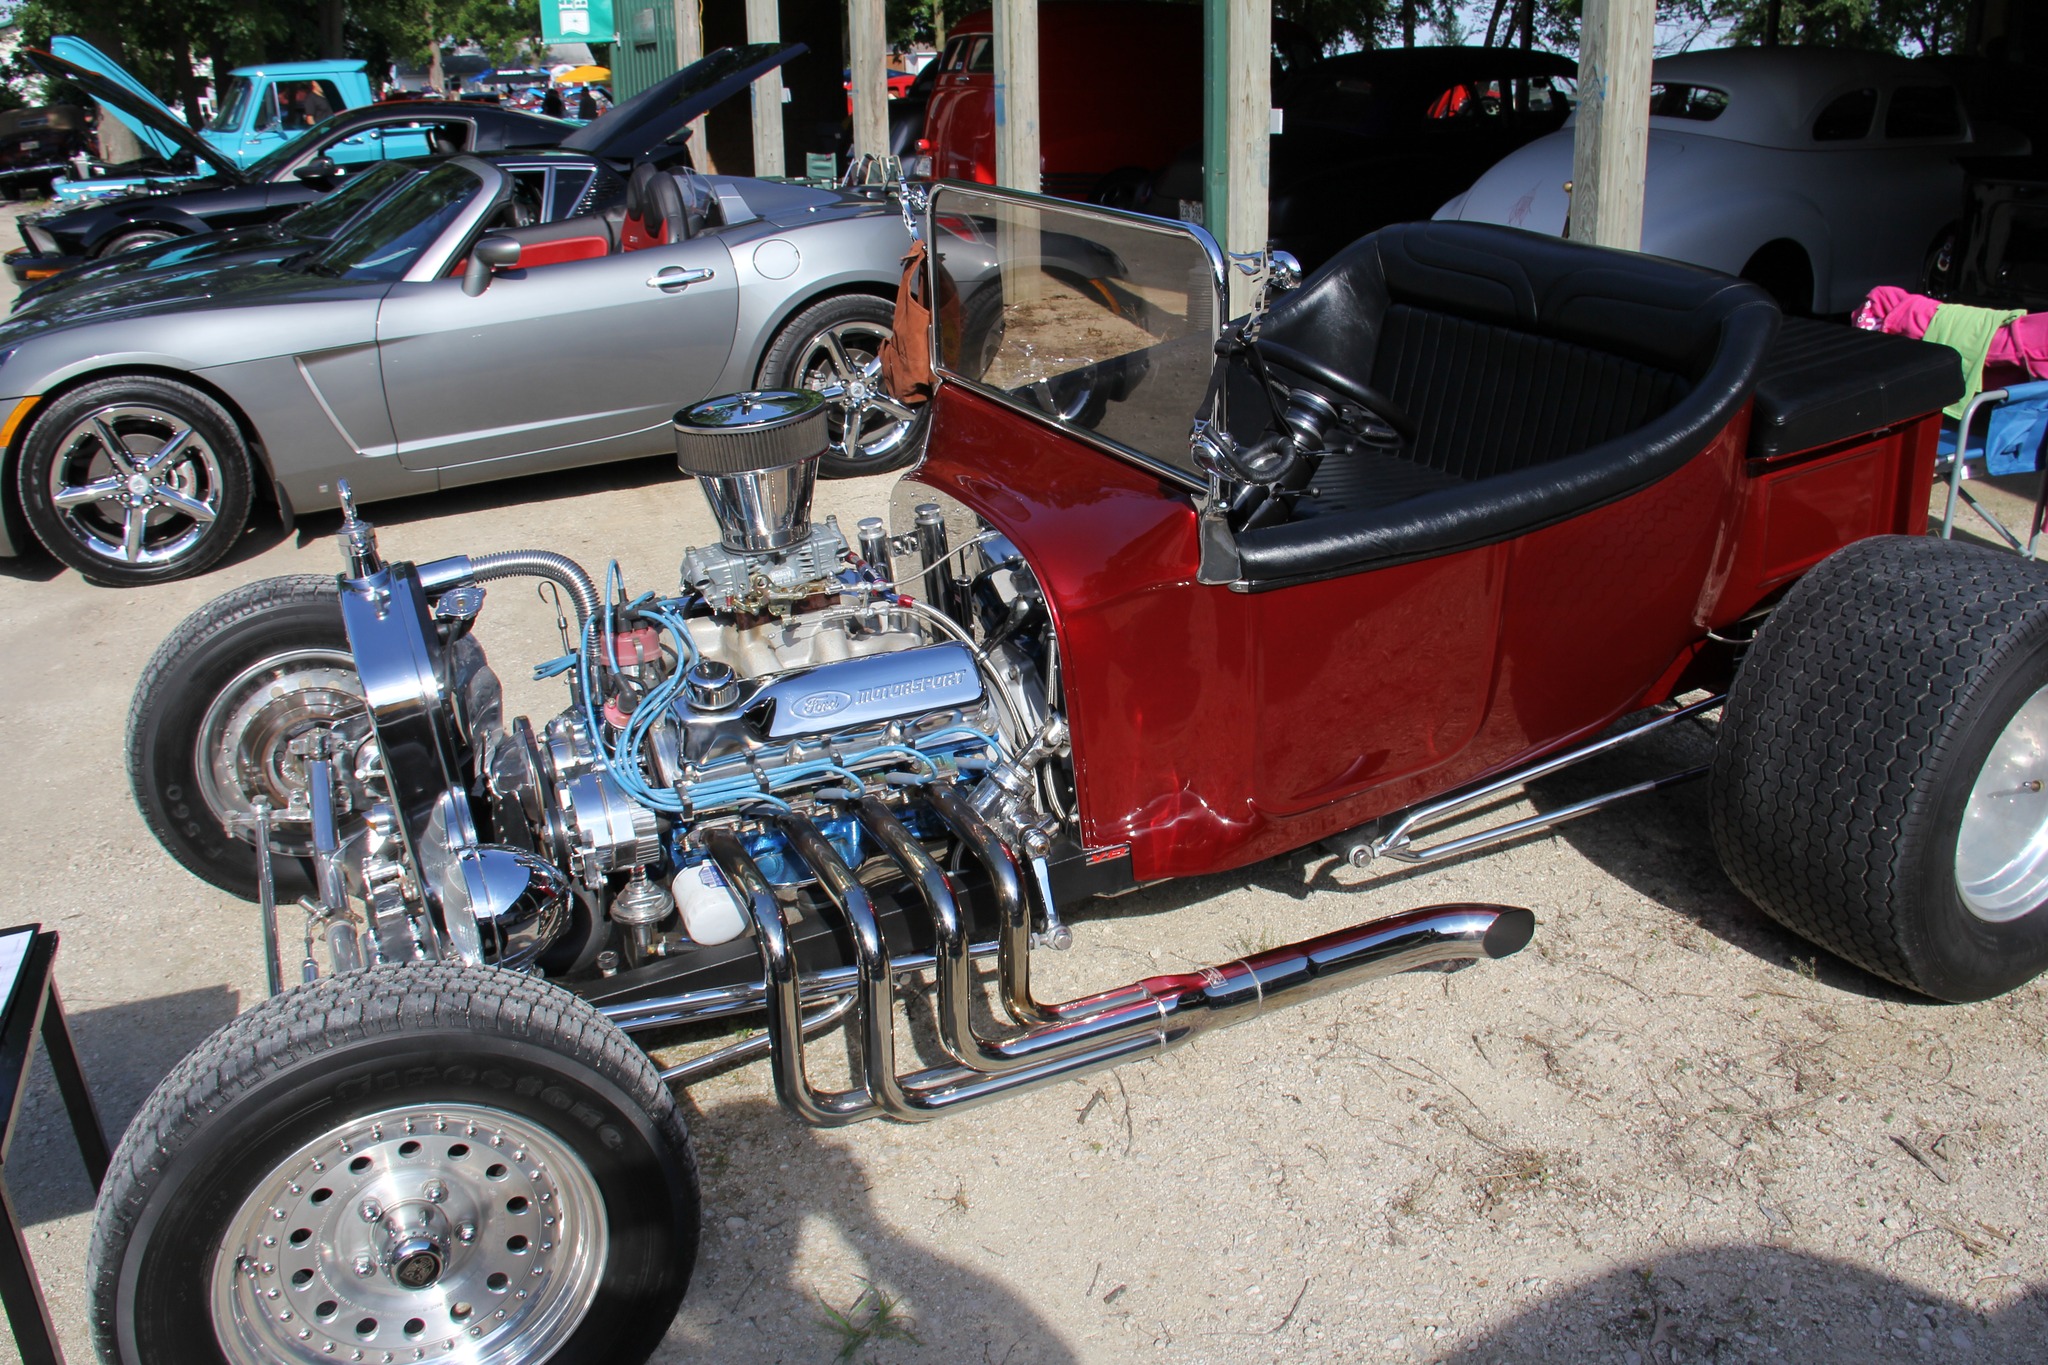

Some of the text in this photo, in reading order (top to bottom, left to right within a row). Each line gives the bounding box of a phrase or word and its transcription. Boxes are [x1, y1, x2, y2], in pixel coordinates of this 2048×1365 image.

[804, 669, 967, 715] Ford MOTORSPORT
[335, 1063, 623, 1149] Firestone
